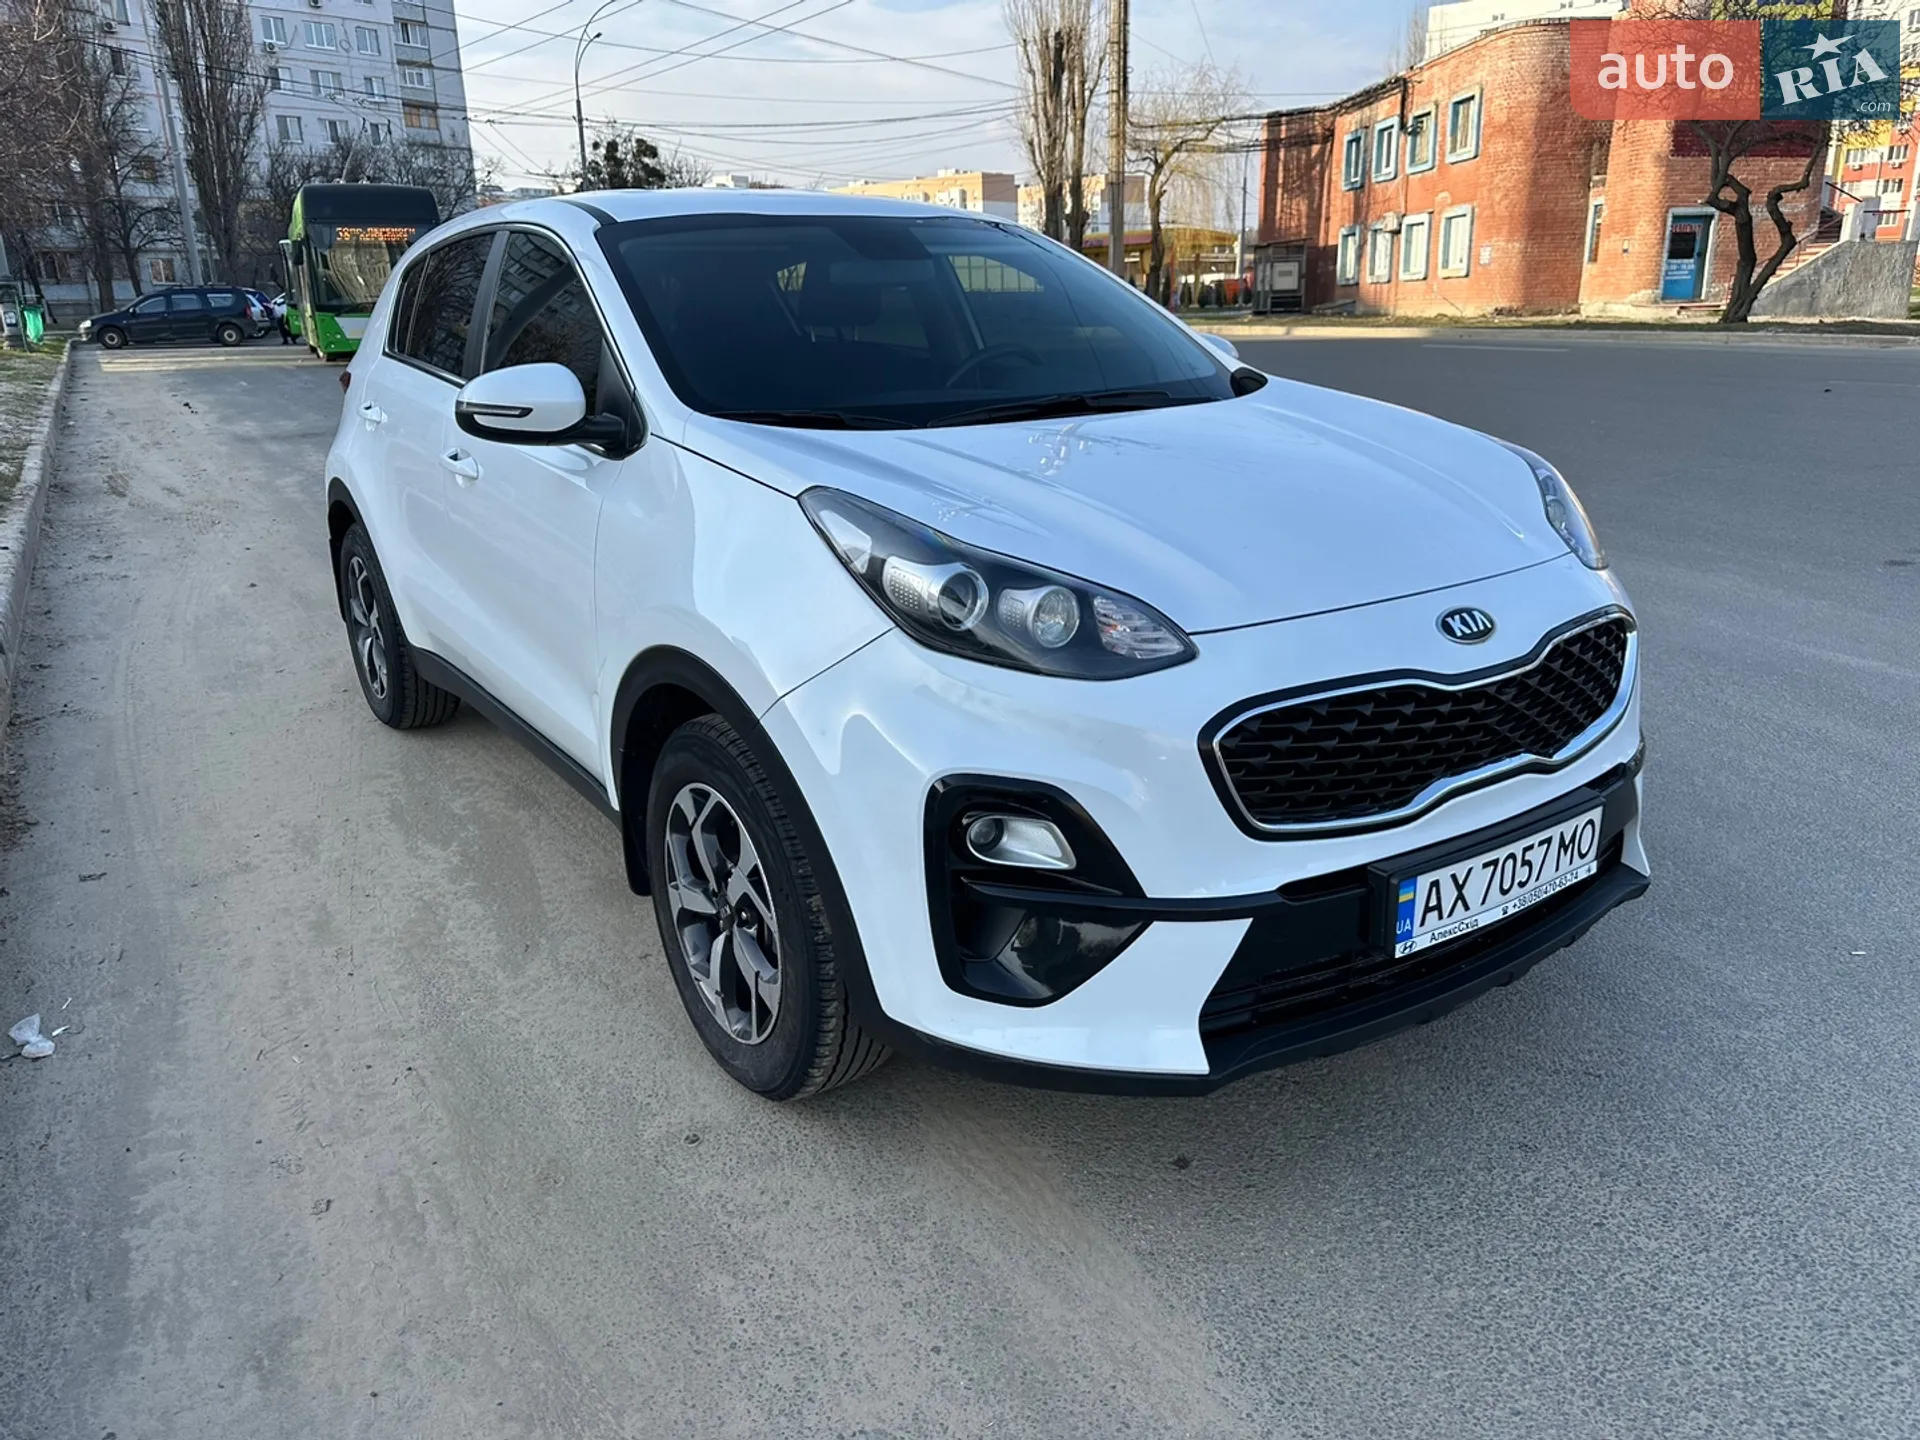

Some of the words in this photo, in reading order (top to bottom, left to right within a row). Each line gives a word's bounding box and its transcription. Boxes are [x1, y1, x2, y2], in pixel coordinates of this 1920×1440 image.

[1445, 610, 1492, 637] KIA
[1419, 866, 1474, 928] AX
[1480, 835, 1553, 906] 7057
[1554, 818, 1596, 873] MO
[1396, 918, 1412, 934] UA
